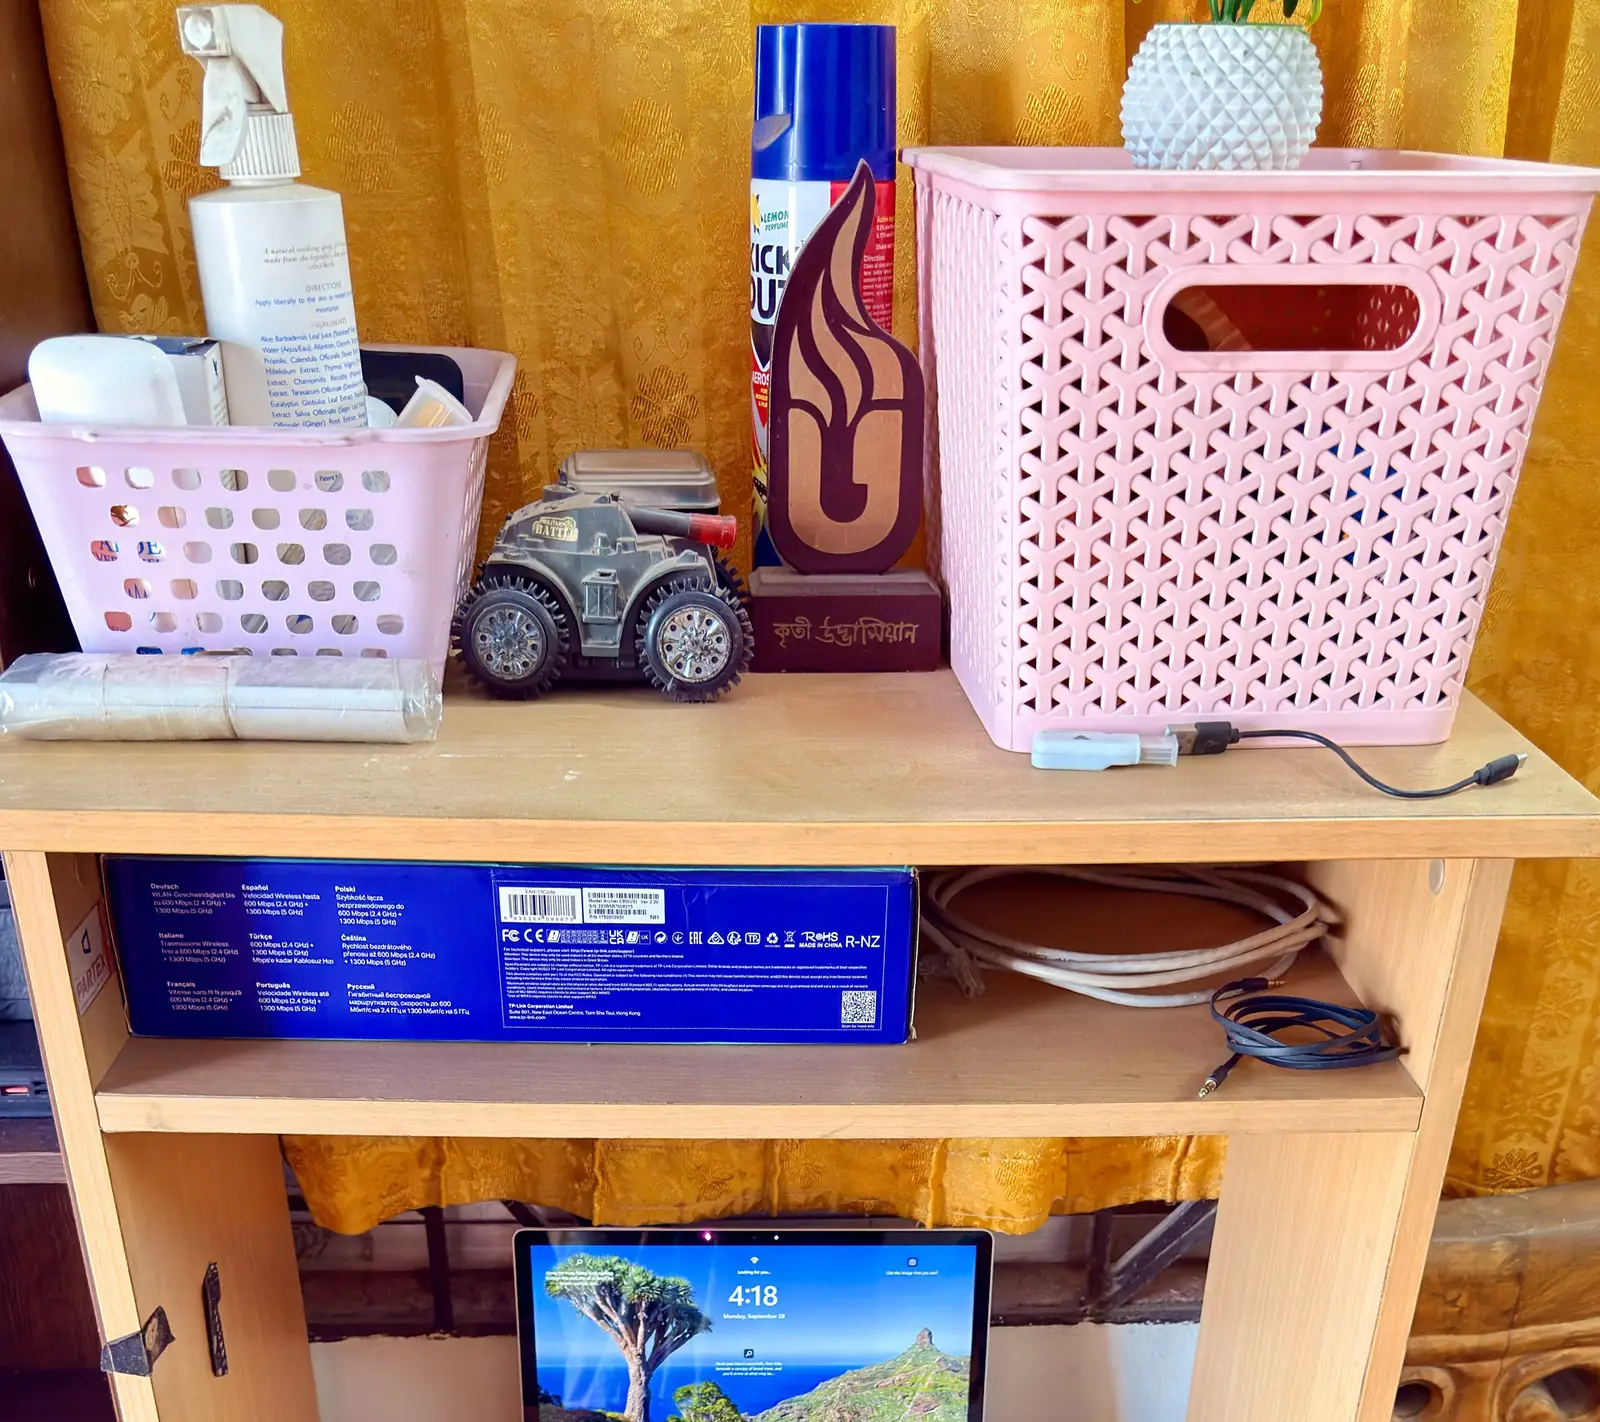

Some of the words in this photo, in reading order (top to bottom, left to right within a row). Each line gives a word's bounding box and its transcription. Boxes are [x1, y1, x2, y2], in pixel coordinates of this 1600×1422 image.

[772, 616, 812, 648] কৃতী
[524, 928, 544, 943] CE
[846, 936, 880, 948] R-NZ
[728, 1285, 778, 1306] 4:18
